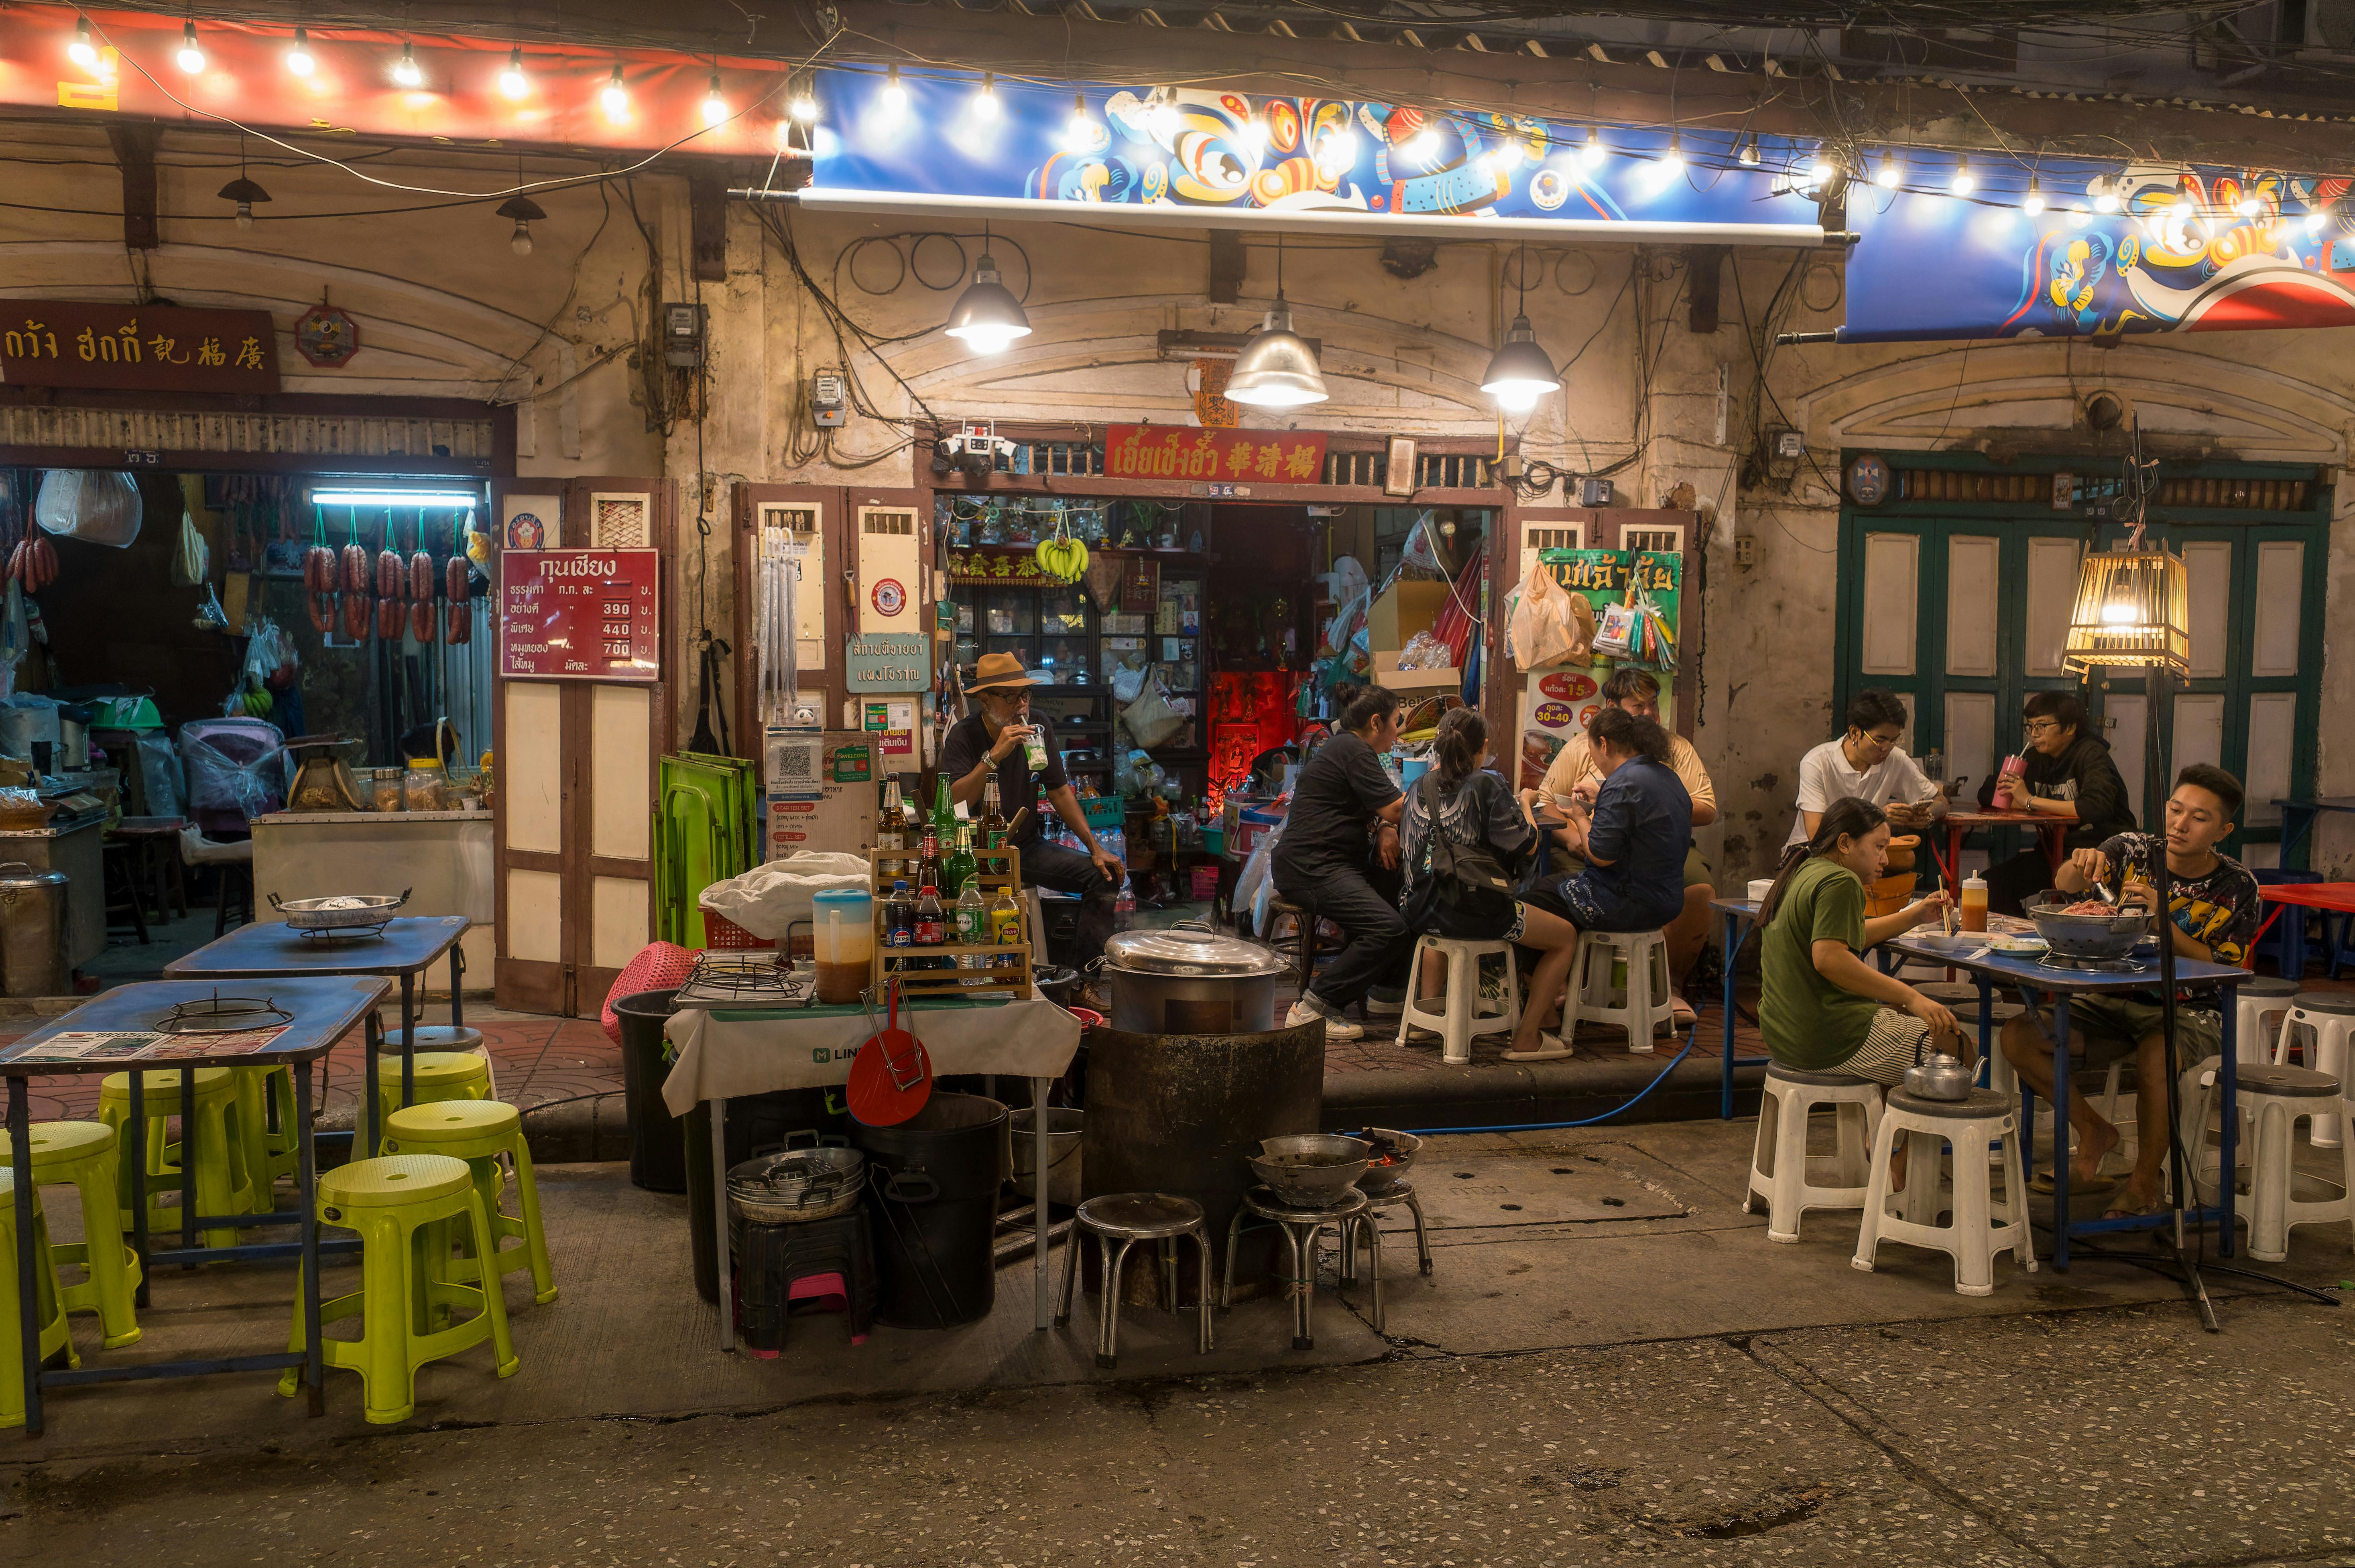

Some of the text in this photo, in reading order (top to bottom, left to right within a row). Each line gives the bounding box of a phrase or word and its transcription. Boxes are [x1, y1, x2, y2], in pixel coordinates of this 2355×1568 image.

[539, 554, 616, 584] กุนเชียง
[510, 585, 544, 595] ธรรมดา
[582, 586, 593, 595] ละ
[641, 586, 651, 595] บ.
[604, 603, 629, 615] 390
[641, 605, 652, 615] บ.
[510, 622, 651, 635] พิเศษ 440 บ.
[510, 643, 549, 656] หมูหยอง
[603, 644, 629, 655] 700
[853, 638, 923, 656] สถานที่ขายยา
[565, 659, 588, 671] มัดละ
[858, 665, 919, 682] แผนโบราณ
